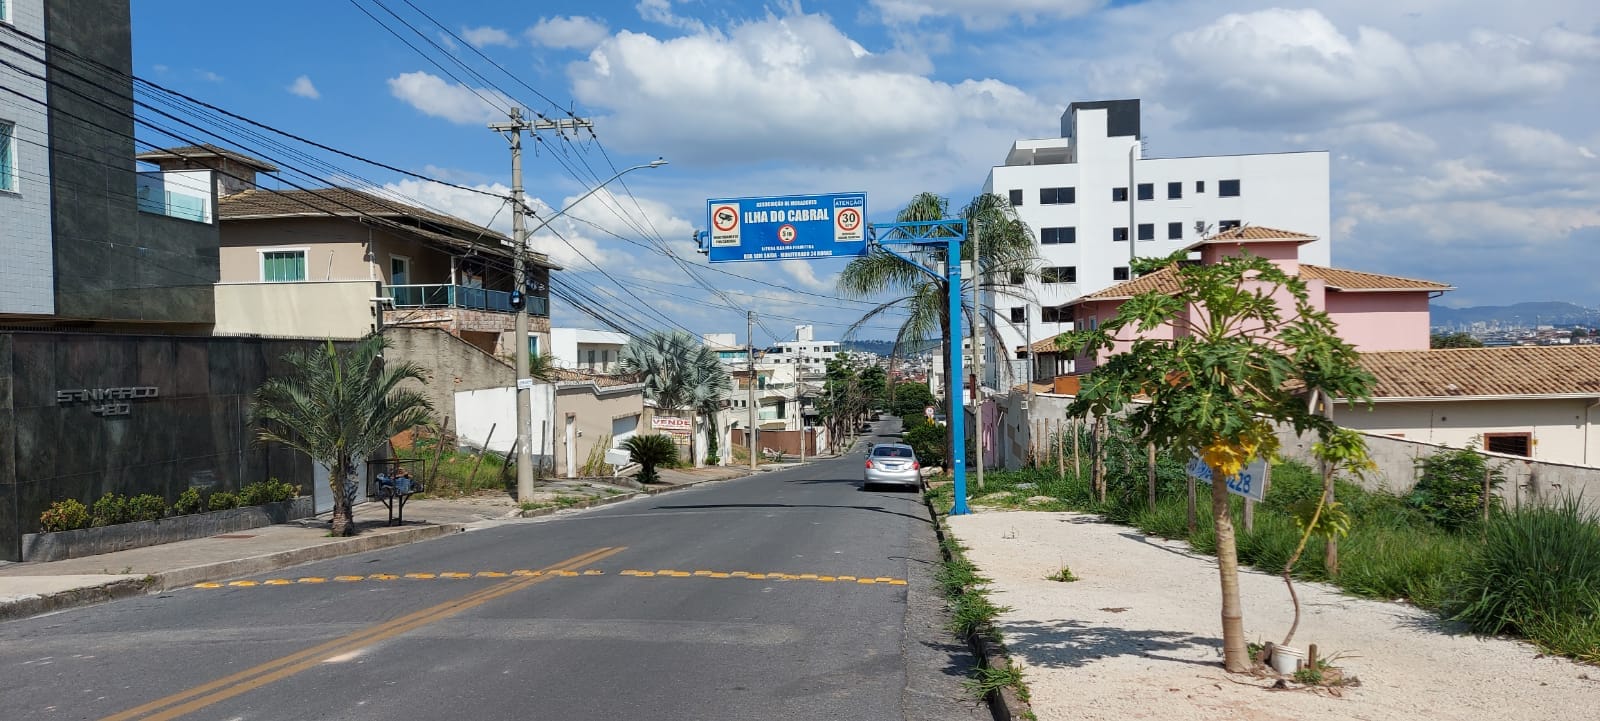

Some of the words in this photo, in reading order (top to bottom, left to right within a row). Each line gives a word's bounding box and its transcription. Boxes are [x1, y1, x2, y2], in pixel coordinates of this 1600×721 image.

[744, 211, 768, 223] ILHA
[770, 210, 785, 222] DO
[787, 208, 829, 221] CABRAL
[842, 213, 856, 223] 30
